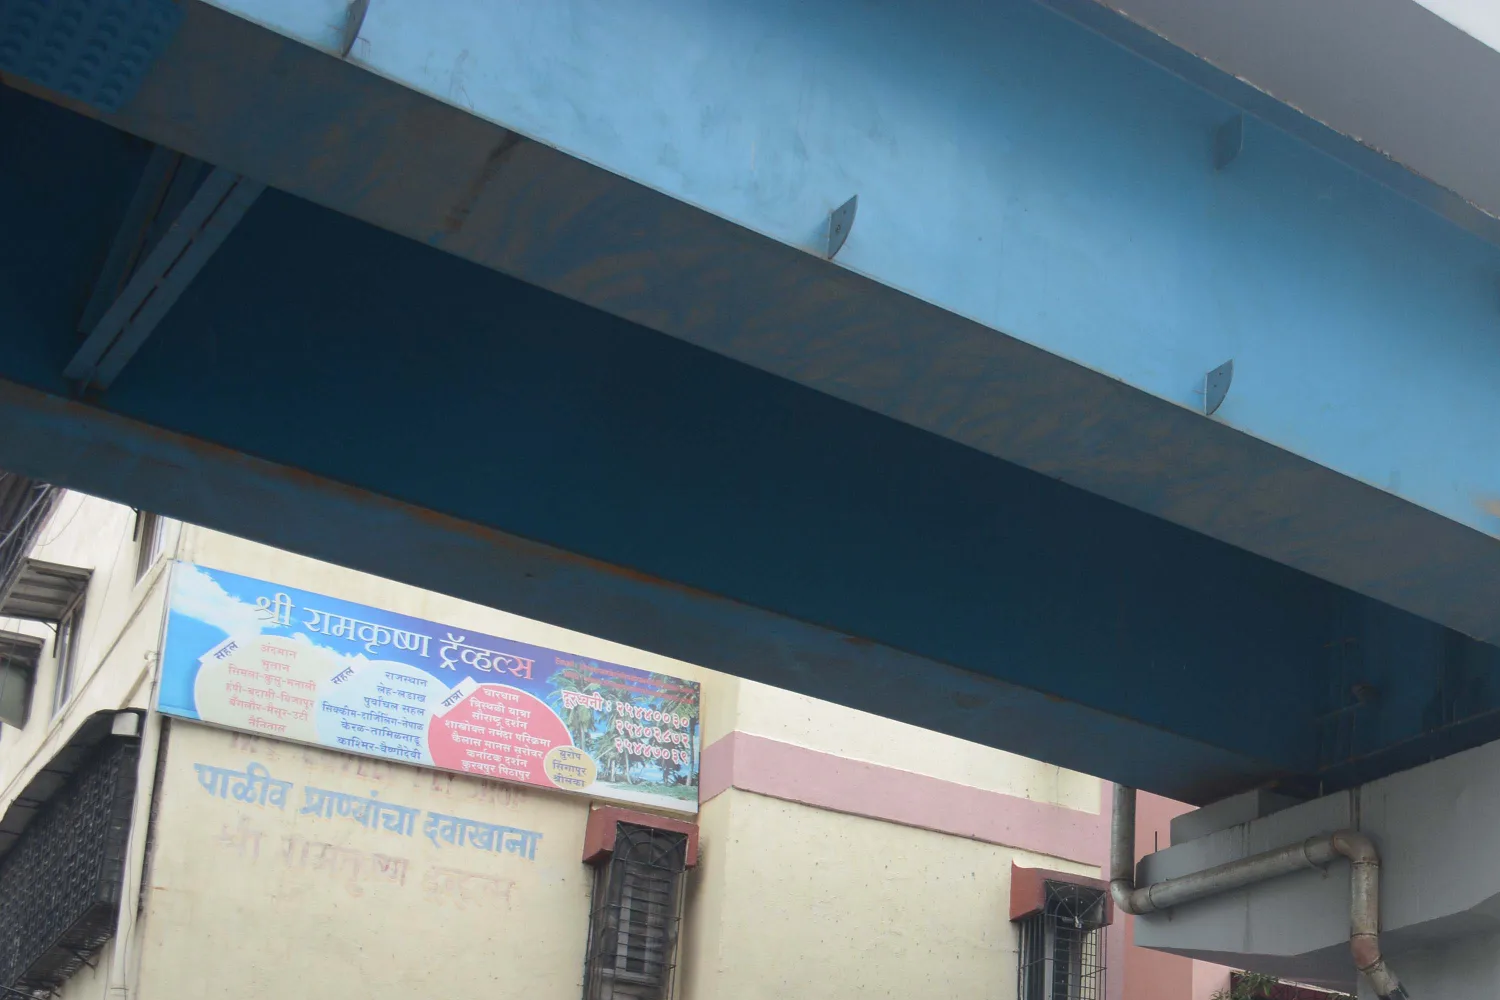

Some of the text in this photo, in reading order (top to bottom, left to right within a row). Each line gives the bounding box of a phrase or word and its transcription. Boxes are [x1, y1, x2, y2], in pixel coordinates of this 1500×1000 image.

[255, 592, 296, 626] श्री
[303, 607, 432, 658] रामकृष्ण
[440, 632, 535, 681] ट्रॅव्हल्स
[213, 640, 240, 661] सहल
[330, 666, 355, 686] सहल
[385, 670, 429, 689] राजस्थान
[441, 688, 465, 709] यात्रा
[483, 687, 520, 703] चारधाम
[402, 704, 426, 717] सहल
[508, 705, 531, 719] यात्रा
[561, 689, 690, 729] दूरध्वनी २५४४००३०
[505, 715, 529, 731] दर्शन
[516, 731, 552, 749] परिक्रमा
[615, 719, 690, 749] २५४०२८७२
[451, 731, 544, 759] कैलास मानस सरोवर
[466, 747, 529, 768] कर्नाटक दर्शन
[193, 761, 294, 812] पाळीव
[300, 789, 422, 837] प्राण्यांचा
[424, 810, 544, 861] दवाखाना
